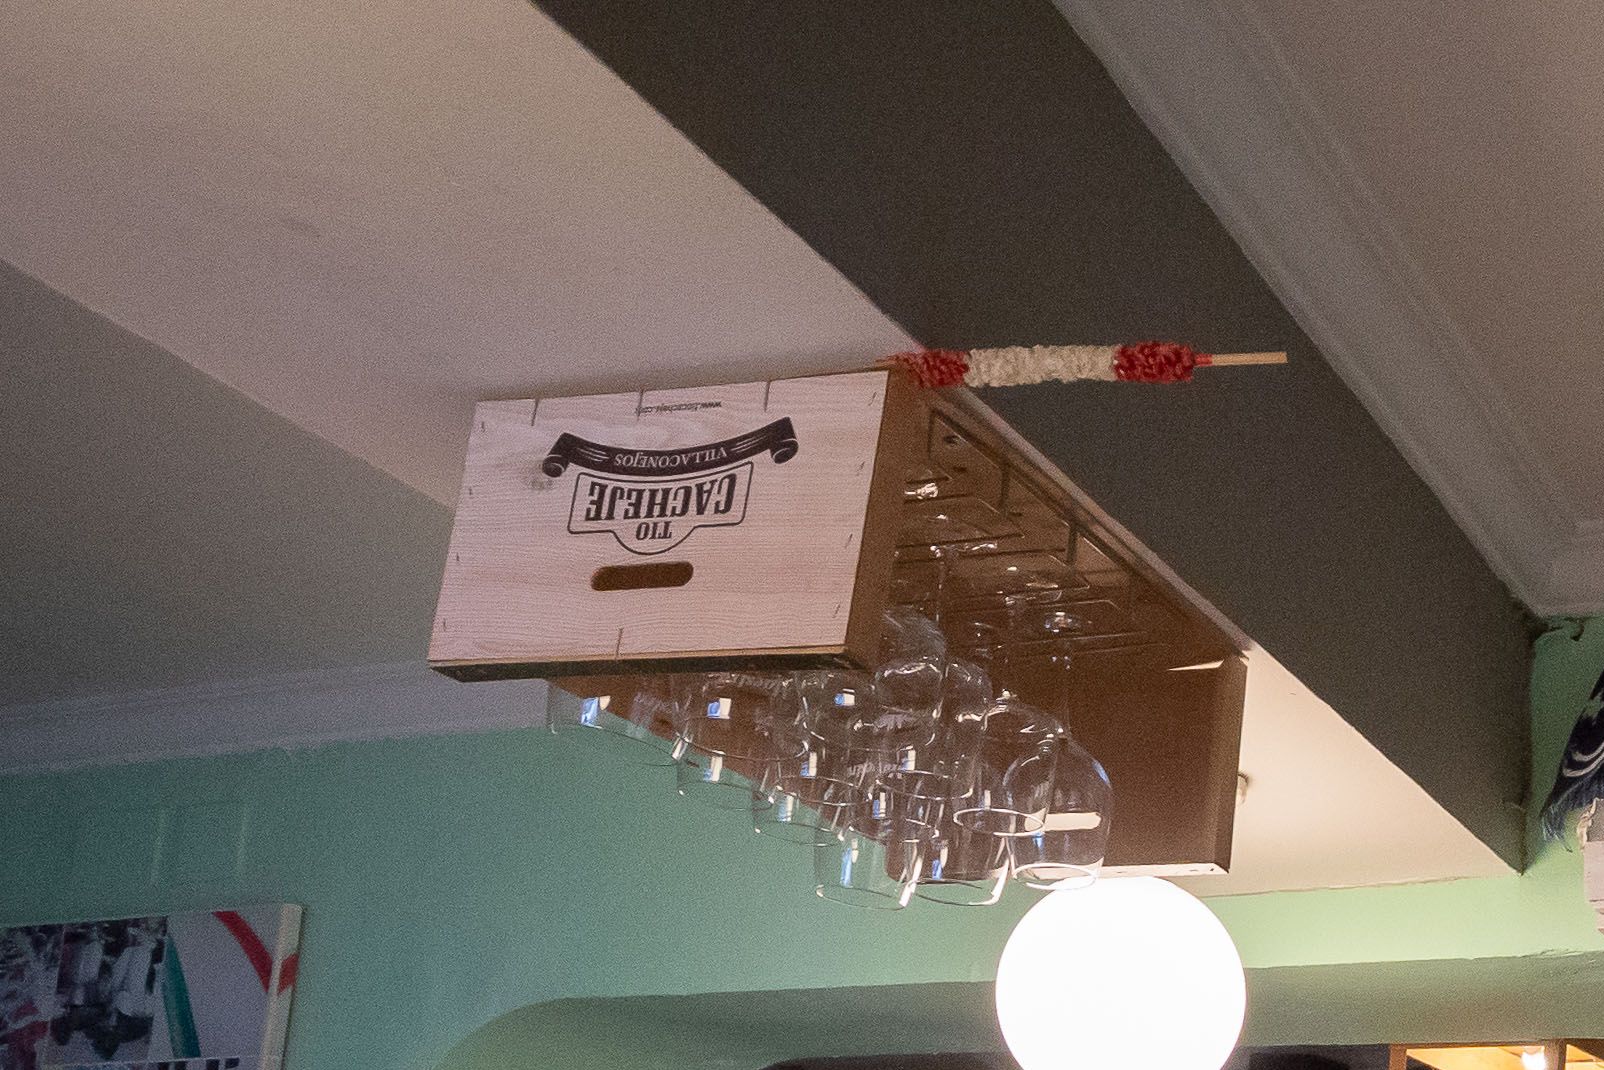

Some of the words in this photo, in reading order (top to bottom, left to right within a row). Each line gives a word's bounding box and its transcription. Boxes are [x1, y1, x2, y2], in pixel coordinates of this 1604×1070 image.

[614, 447, 728, 468] VILLACONEJOS
[585, 473, 737, 521] CACHEJE
[636, 520, 673, 540] TIO
